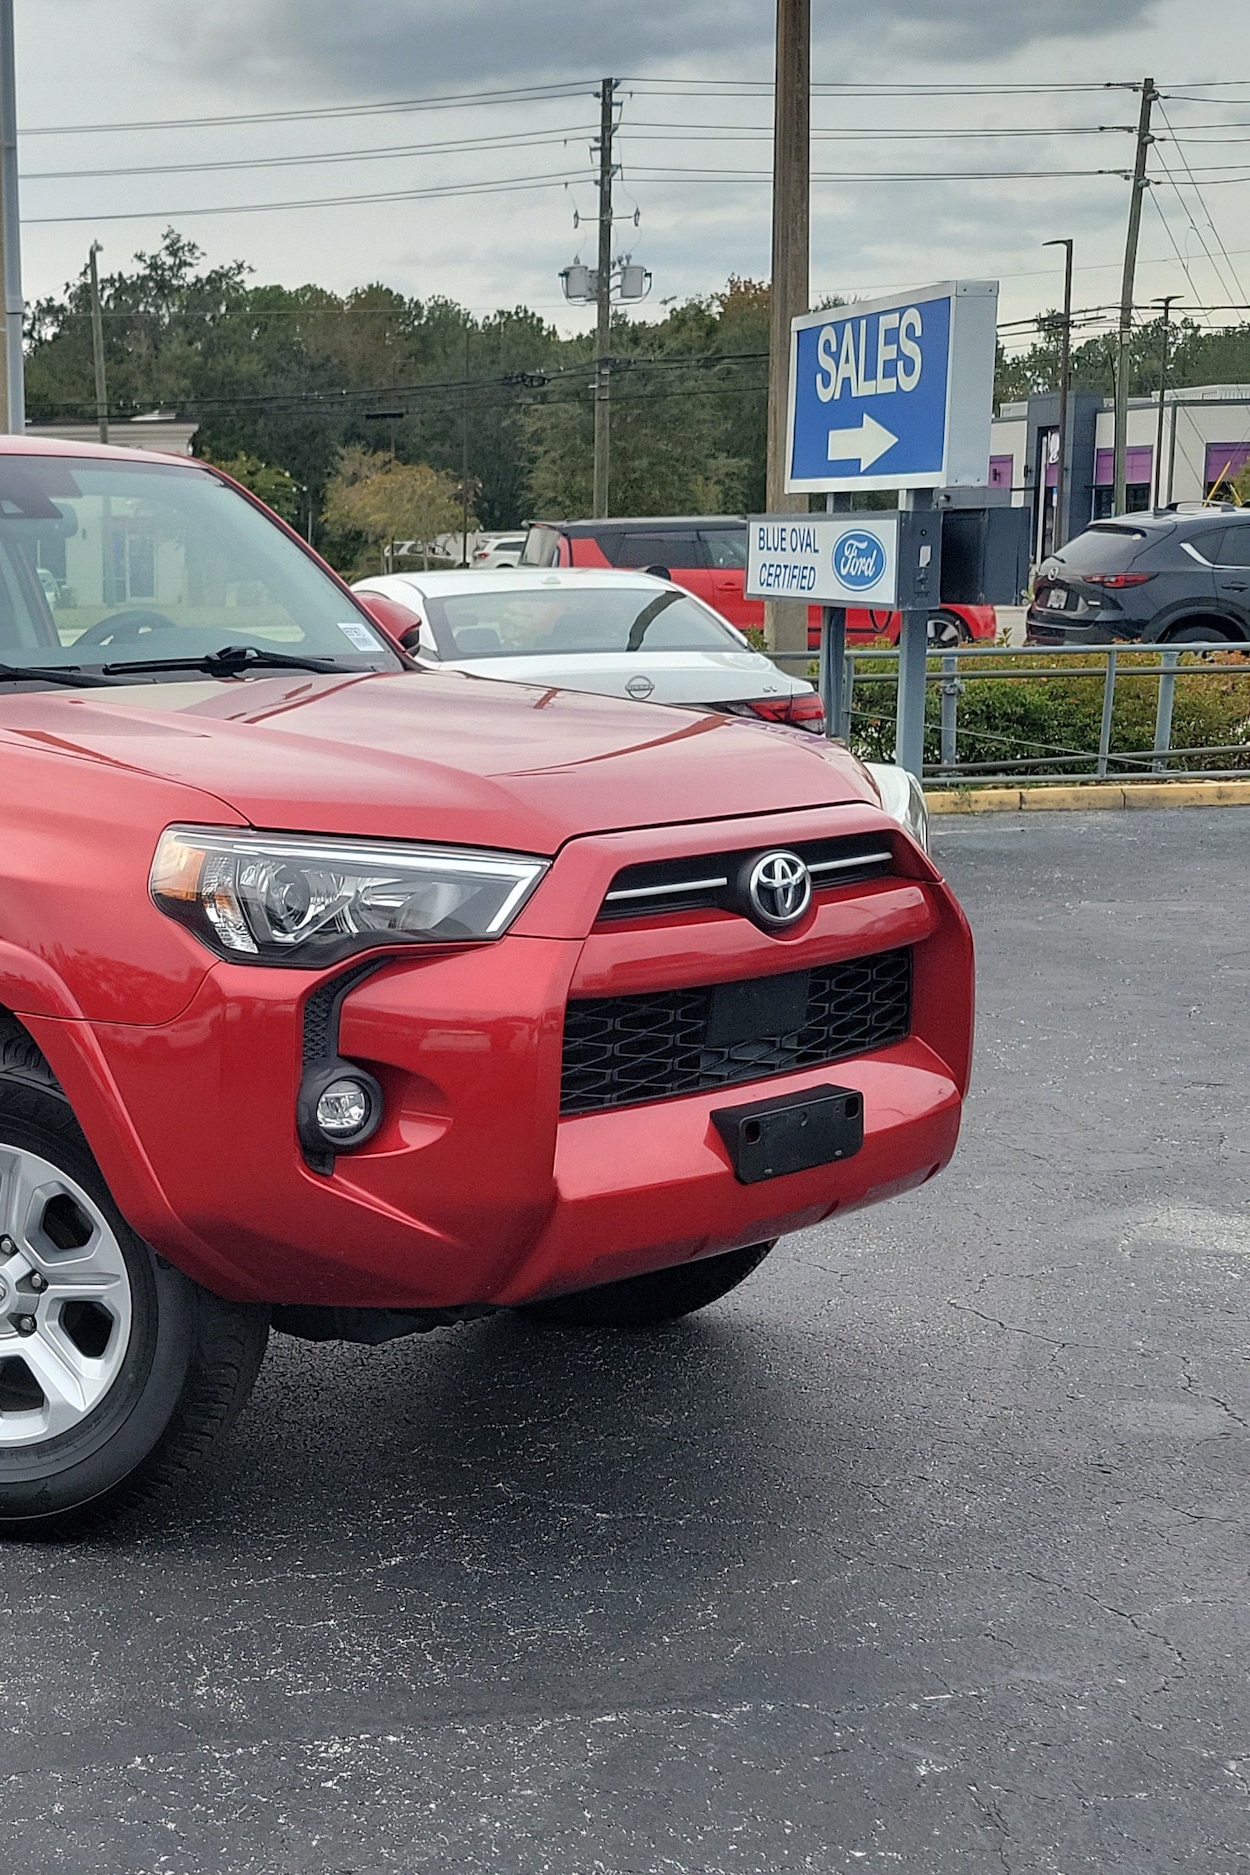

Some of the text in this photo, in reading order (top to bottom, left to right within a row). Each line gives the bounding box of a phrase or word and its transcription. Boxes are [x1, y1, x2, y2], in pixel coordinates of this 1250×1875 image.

[816, 308, 922, 403] SALES
[758, 527, 819, 554] BLUE OVAL
[840, 538, 878, 579] Ford
[759, 562, 817, 592] CERTIFIED
